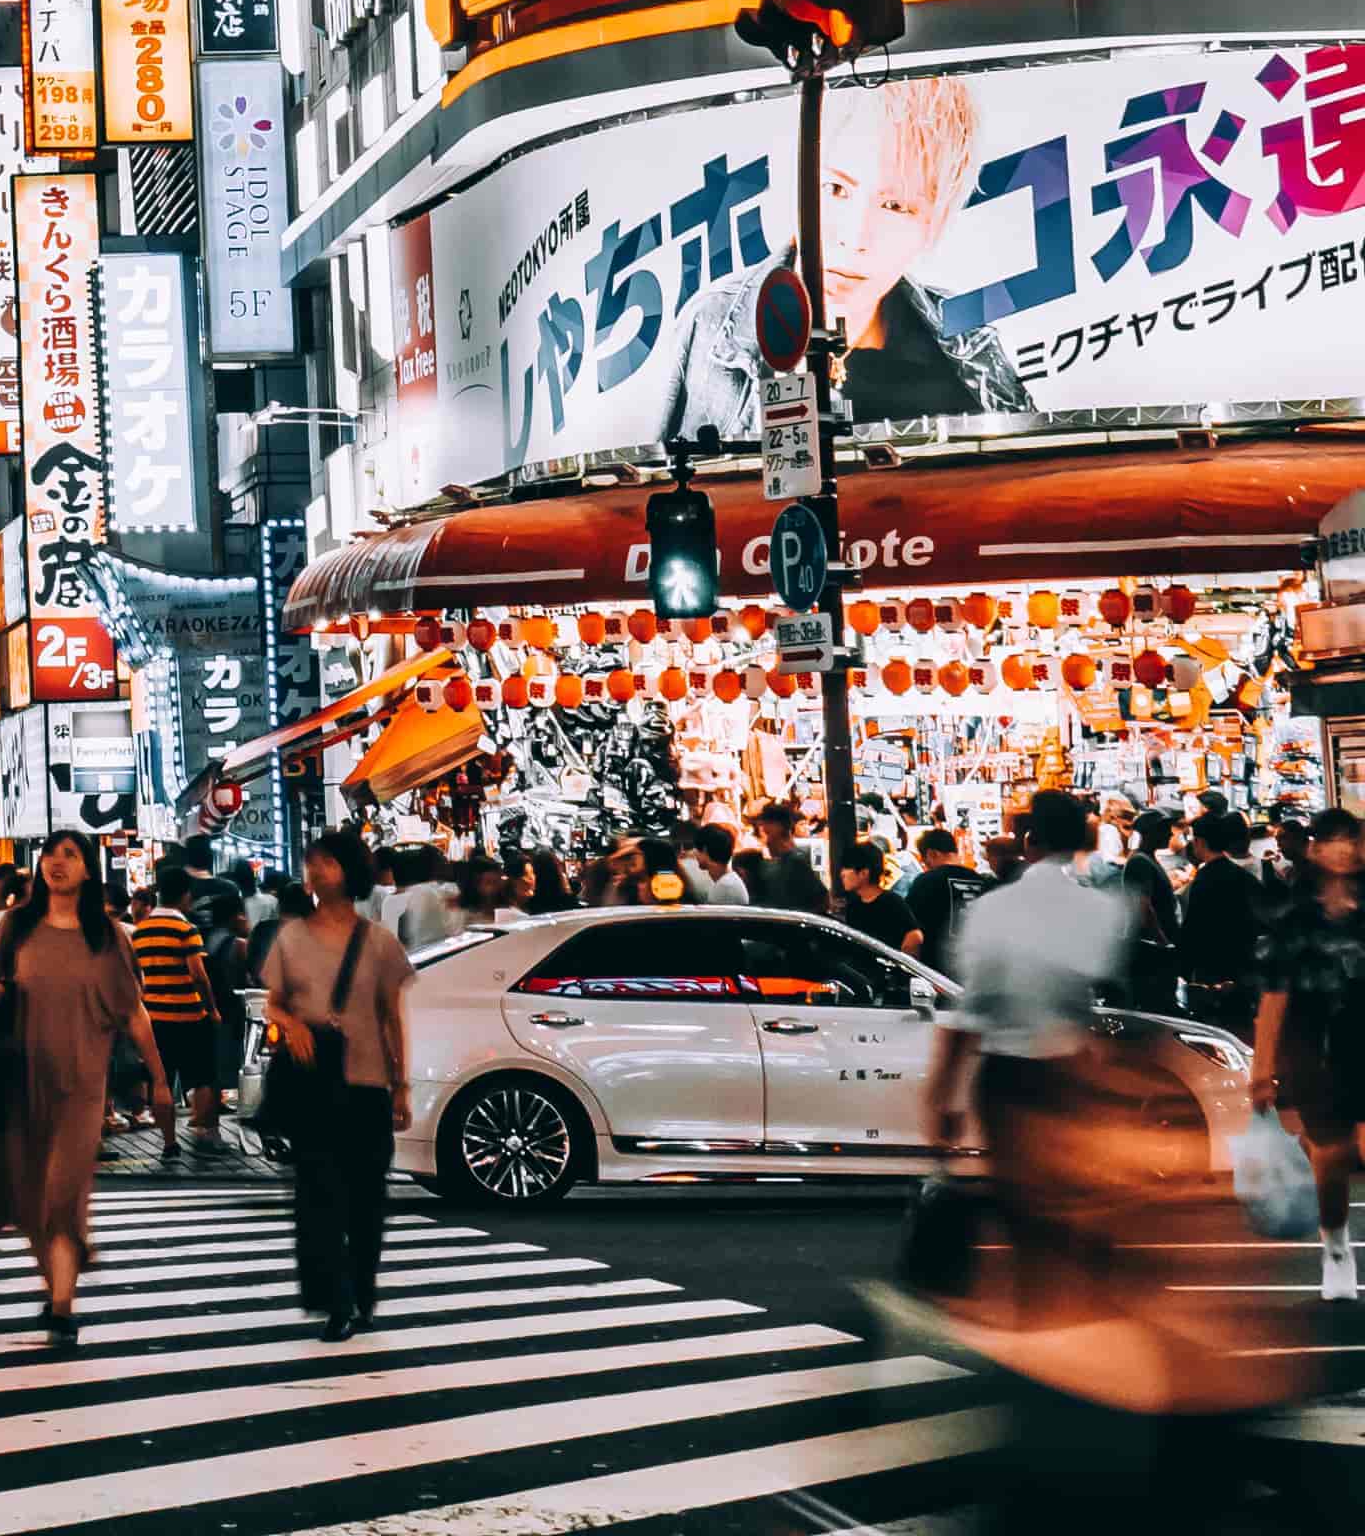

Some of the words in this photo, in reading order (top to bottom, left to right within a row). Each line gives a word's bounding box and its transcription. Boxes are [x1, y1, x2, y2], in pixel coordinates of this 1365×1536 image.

[134, 36, 167, 123] 280
[224, 165, 249, 258] STAGE
[246, 166, 271, 240] IDOL
[40, 185, 79, 387] きんくら酒場
[229, 290, 272, 317] 5F
[116, 264, 182, 516] カラオケ
[415, 346, 435, 379] free
[781, 531, 802, 596] P
[797, 565, 815, 594] 40
[35, 624, 89, 668] 2F
